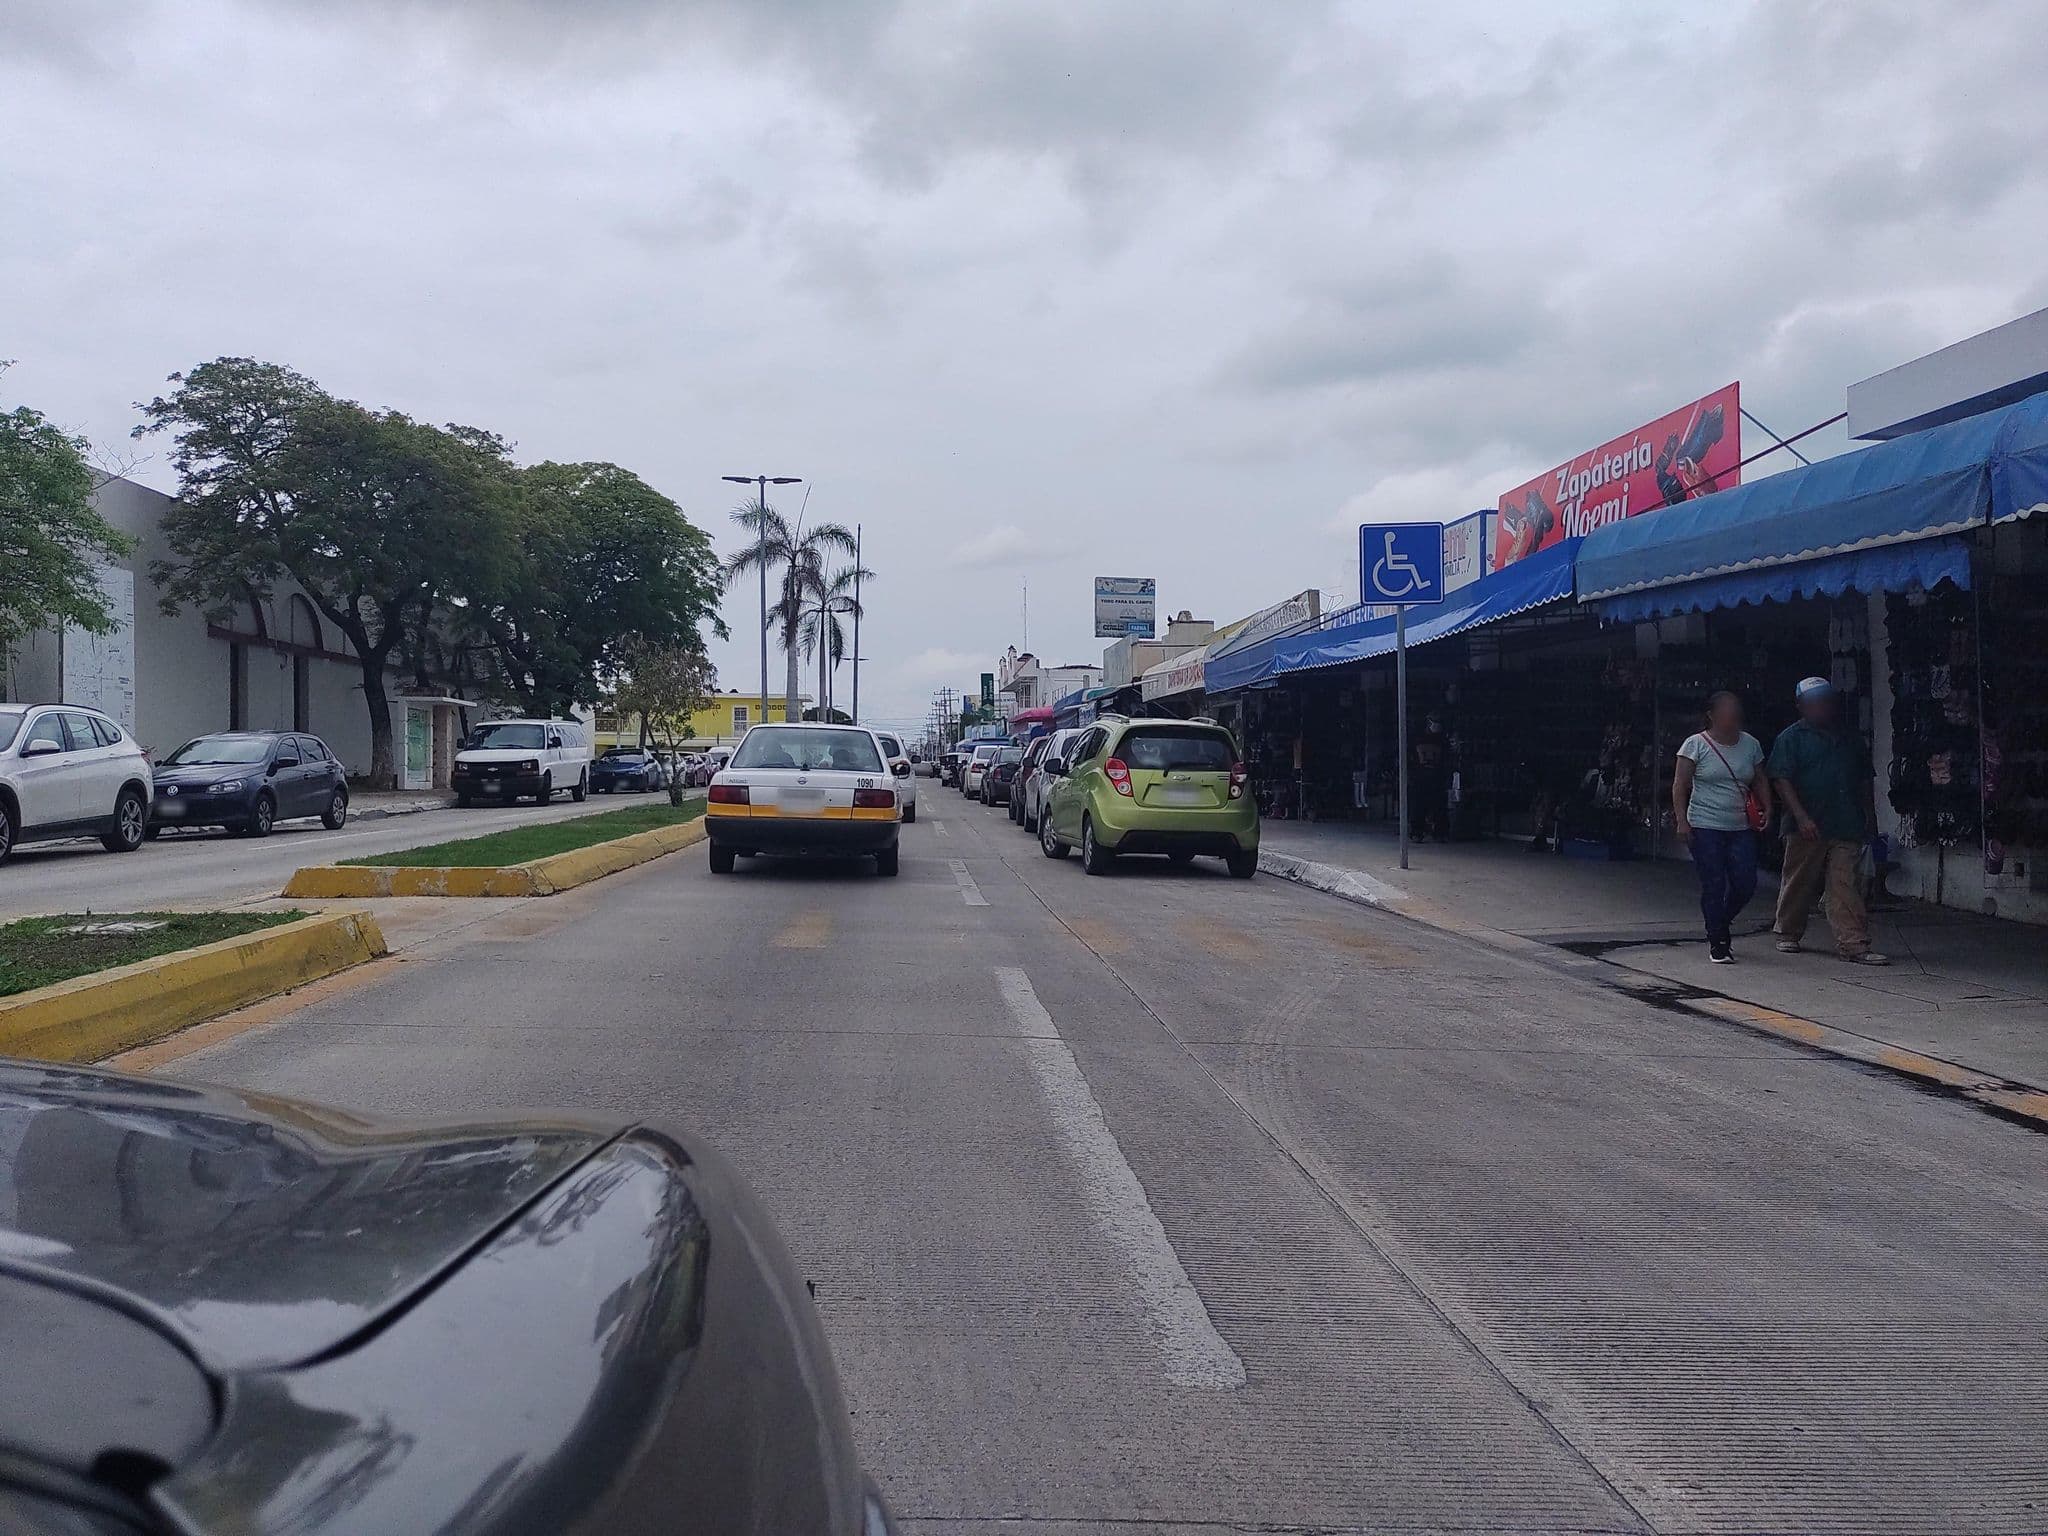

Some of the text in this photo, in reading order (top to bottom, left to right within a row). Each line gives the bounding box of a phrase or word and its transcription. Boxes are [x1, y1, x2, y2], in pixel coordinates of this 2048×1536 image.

[1555, 435, 1652, 504] Zapatería
[1561, 482, 1630, 539] Noemi
[856, 777, 874, 789] 1090
